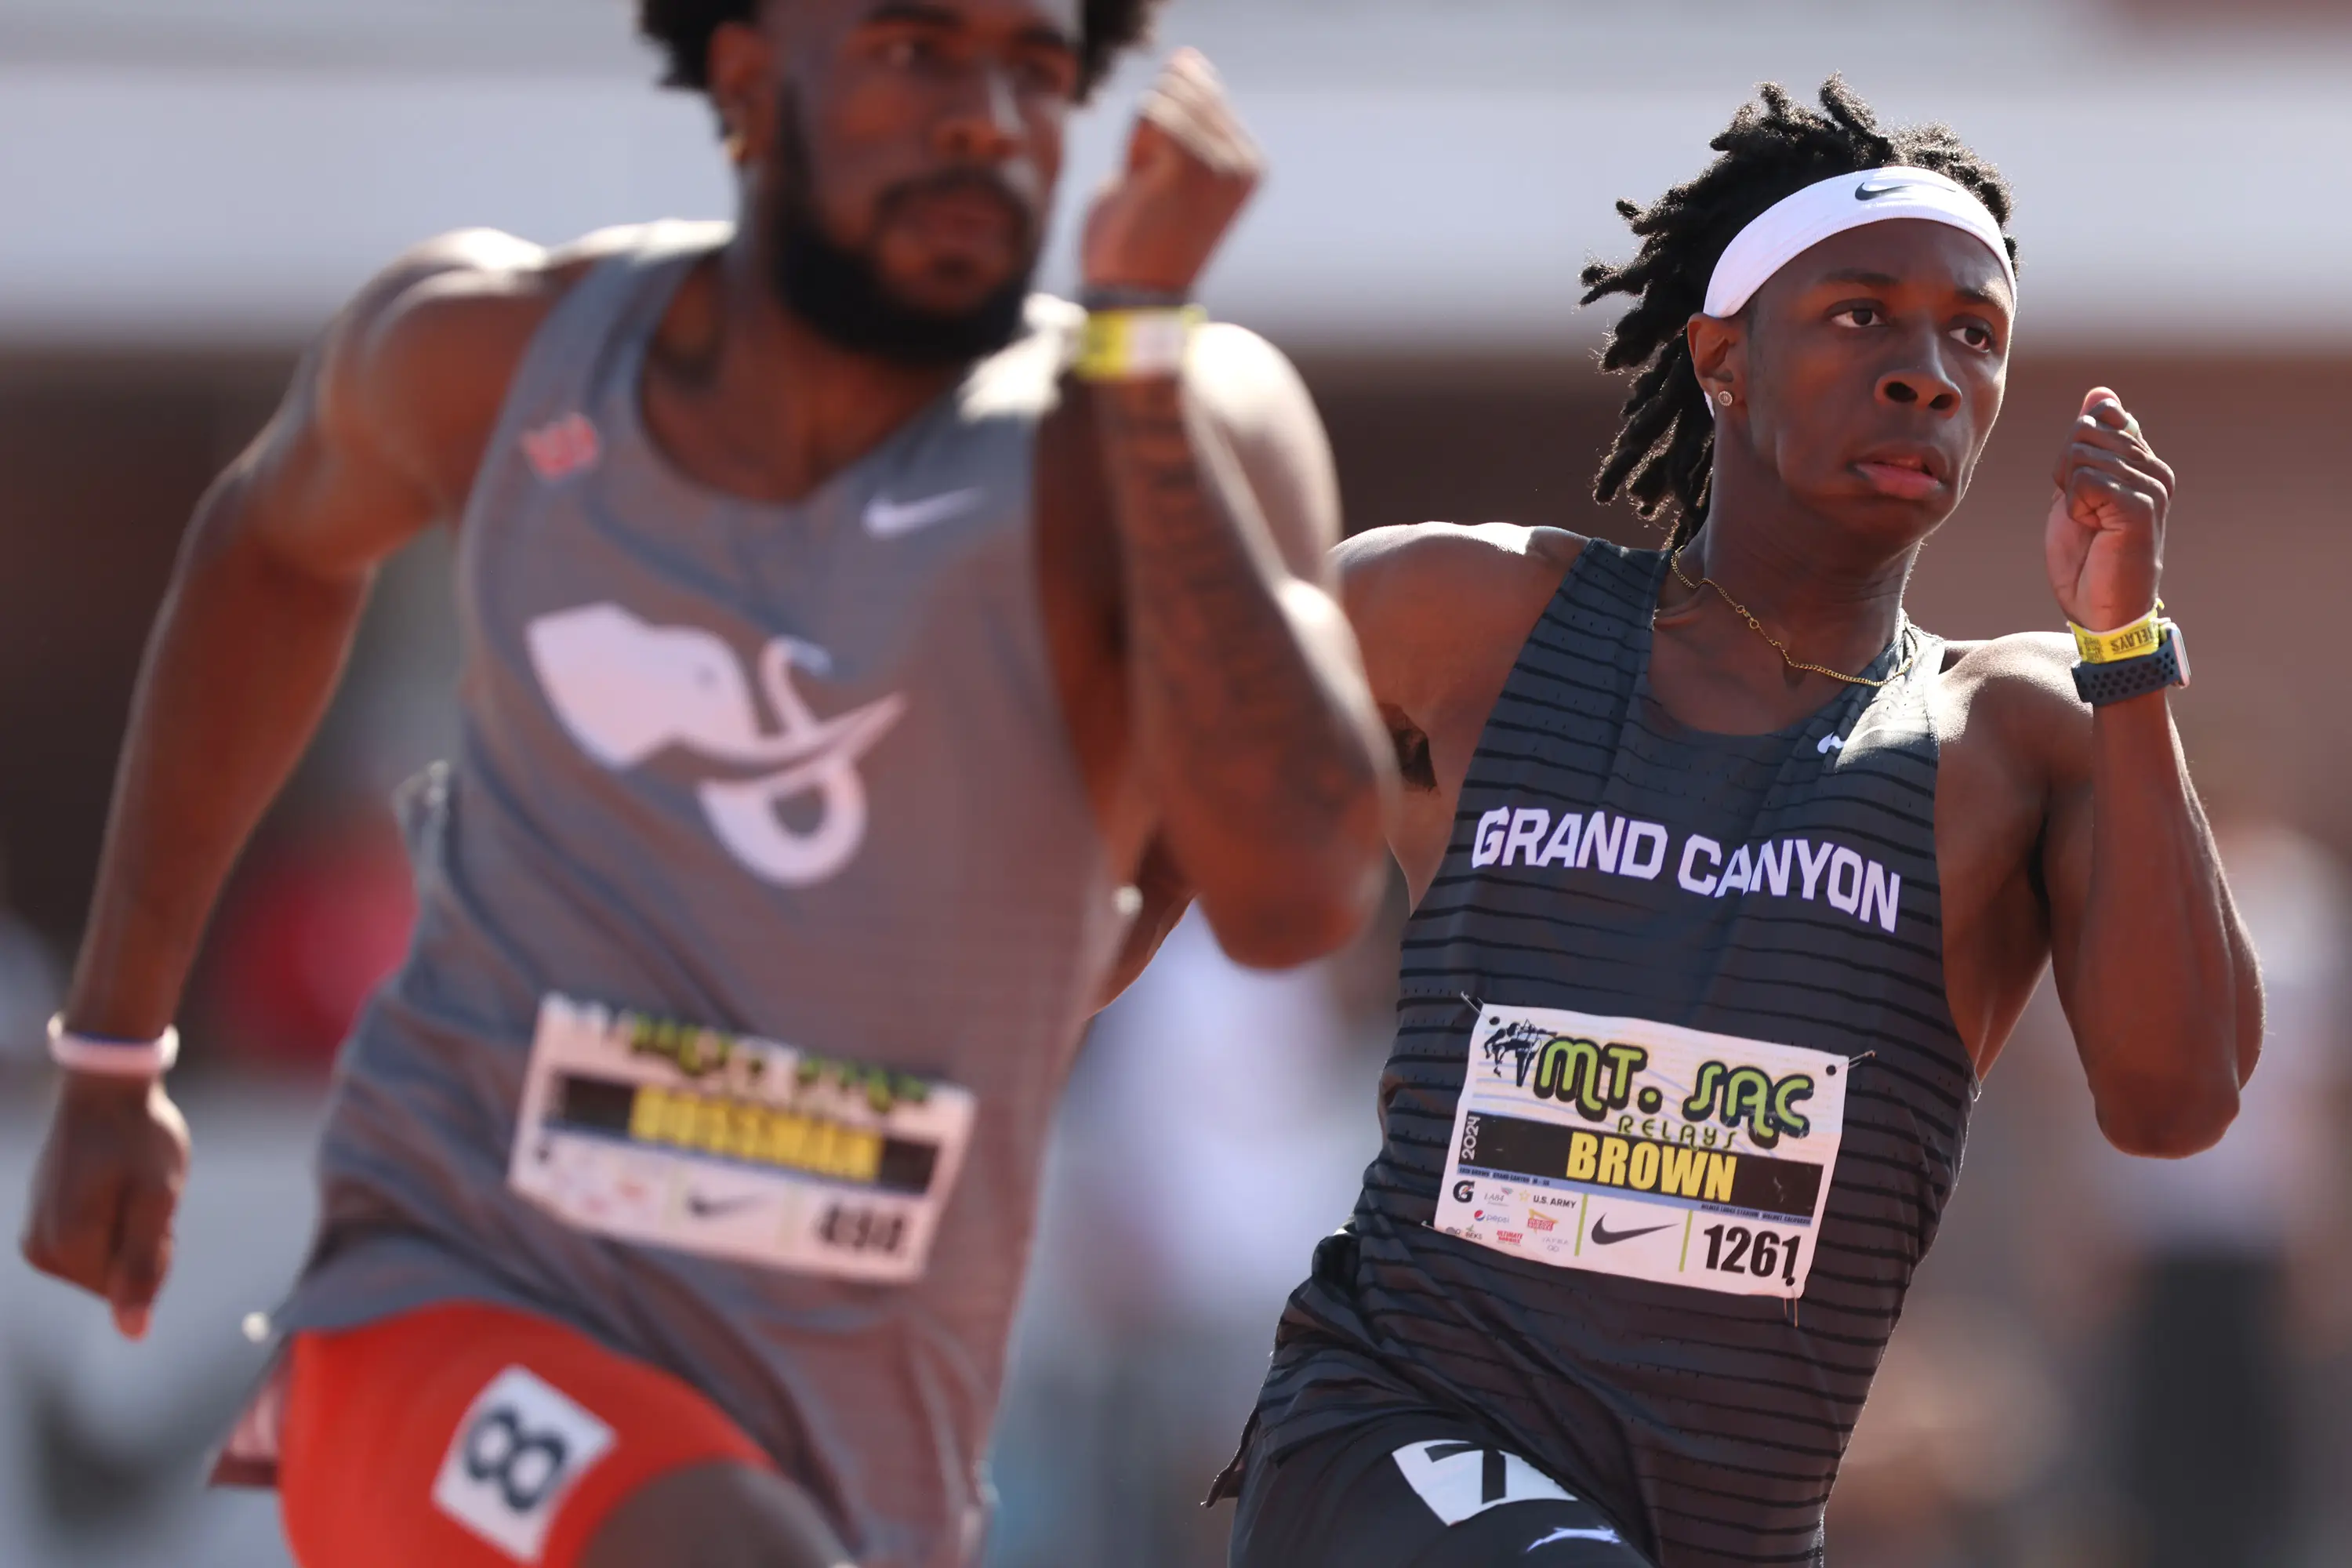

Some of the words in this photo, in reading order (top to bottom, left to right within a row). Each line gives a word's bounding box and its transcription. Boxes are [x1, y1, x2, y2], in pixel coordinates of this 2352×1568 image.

[1472, 806, 1668, 880] GRAND
[1678, 833, 1900, 933] CANYON
[1534, 1036, 1662, 1122] MT.
[1682, 1061, 1814, 1149] SAC
[1461, 1116, 1480, 1160] 2024
[1617, 1116, 1737, 1151] RELAYS
[1453, 1180, 1475, 1203] G
[1566, 1132, 1737, 1203] BROWN
[1486, 1214, 1510, 1224] pepsi
[1534, 1195, 1548, 1203] U.S.
[1550, 1198, 1577, 1208] ARMY
[1704, 1224, 1801, 1279] 1261
[463, 1406, 568, 1512] 8
[1425, 1443, 1506, 1505] 7
